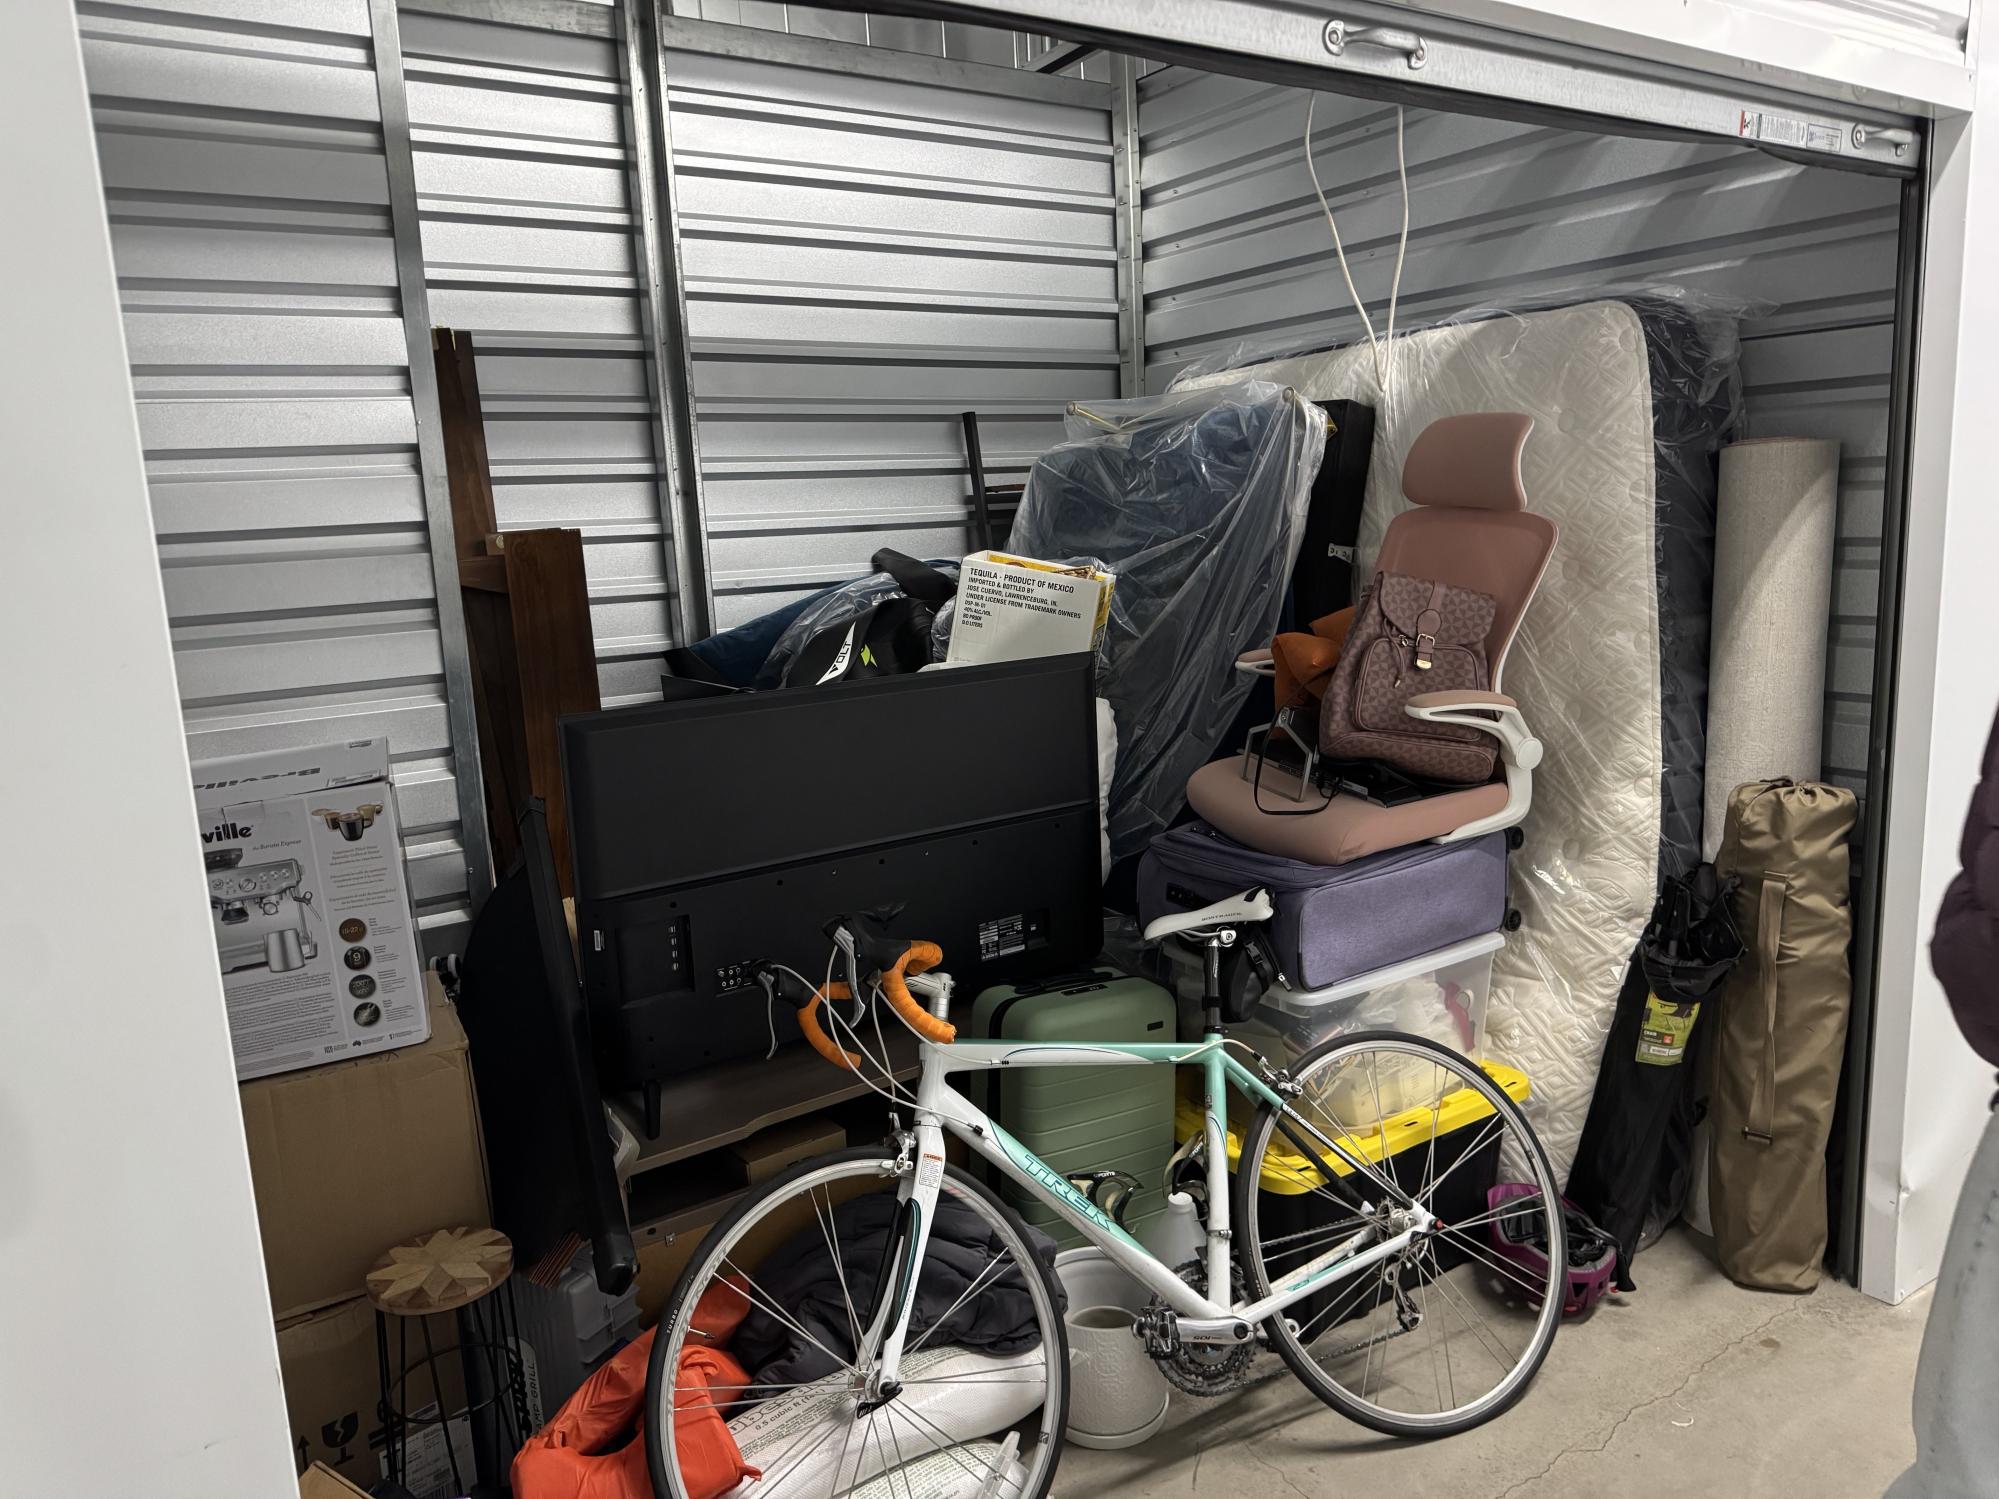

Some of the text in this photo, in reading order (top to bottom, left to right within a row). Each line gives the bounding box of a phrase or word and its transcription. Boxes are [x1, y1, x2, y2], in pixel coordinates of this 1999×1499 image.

[968, 576, 996, 587] IMPORTED
[1002, 582, 1026, 593] BOTTLED
[970, 567, 998, 580] TEQUILA
[1003, 574, 1036, 587] PRODUCT
[1037, 580, 1046, 588] OF
[1047, 582, 1075, 594] MEXICO
[965, 592, 1082, 619] UNDER LICENSE FROM TRADEMARK OWNERS
[967, 584, 980, 593] JOSE
[980, 587, 1004, 598] CUERVO,
[1004, 591, 1050, 606] LAWRENCEBURG,
[828, 641, 851, 676] VOLT
[201, 822, 252, 844] ville
[1024, 1153, 1111, 1232] TREK
[666, 1309, 678, 1335] TURBO
[527, 1362, 540, 1400] GRILL
[755, 1420, 770, 1431] 0.5
[769, 1406, 793, 1422] cubic
